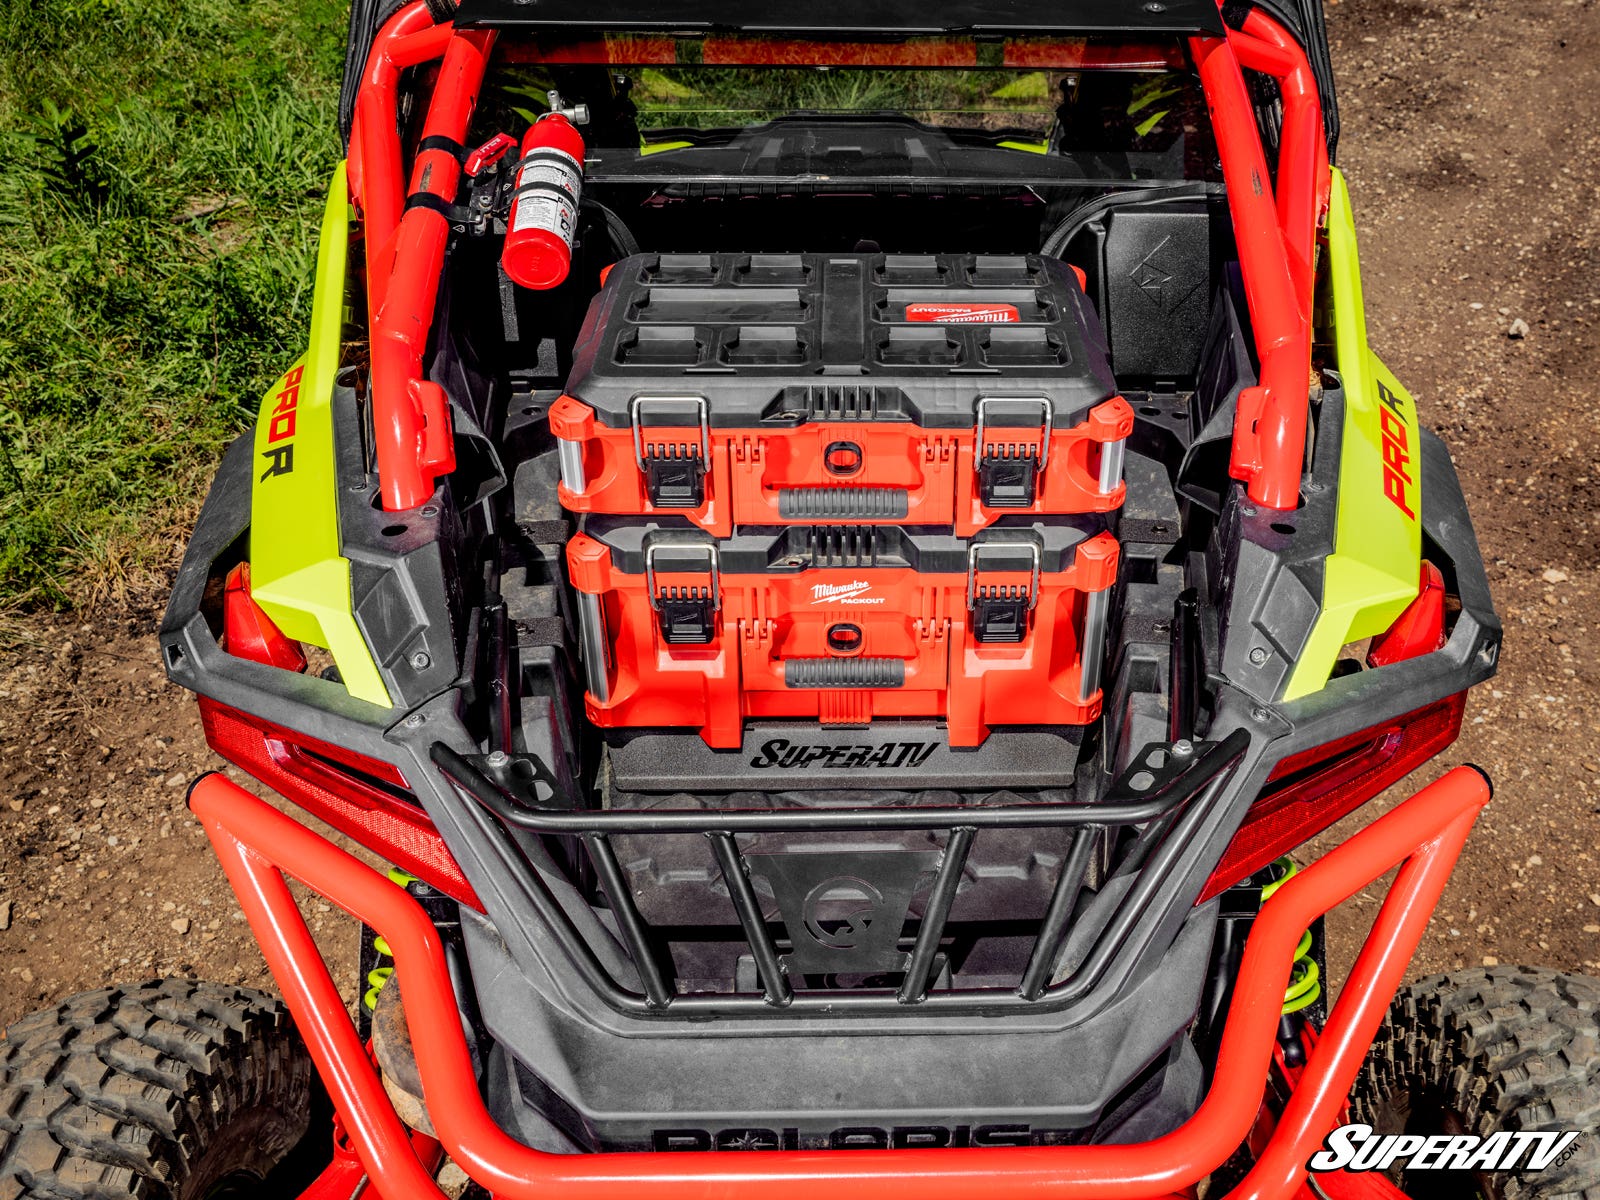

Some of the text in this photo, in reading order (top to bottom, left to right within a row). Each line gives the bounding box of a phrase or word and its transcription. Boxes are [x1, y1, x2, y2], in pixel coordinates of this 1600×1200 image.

[260, 365, 305, 483] PRO R
[1376, 378, 1416, 522] PRO R
[810, 580, 870, 599] Milwaukee
